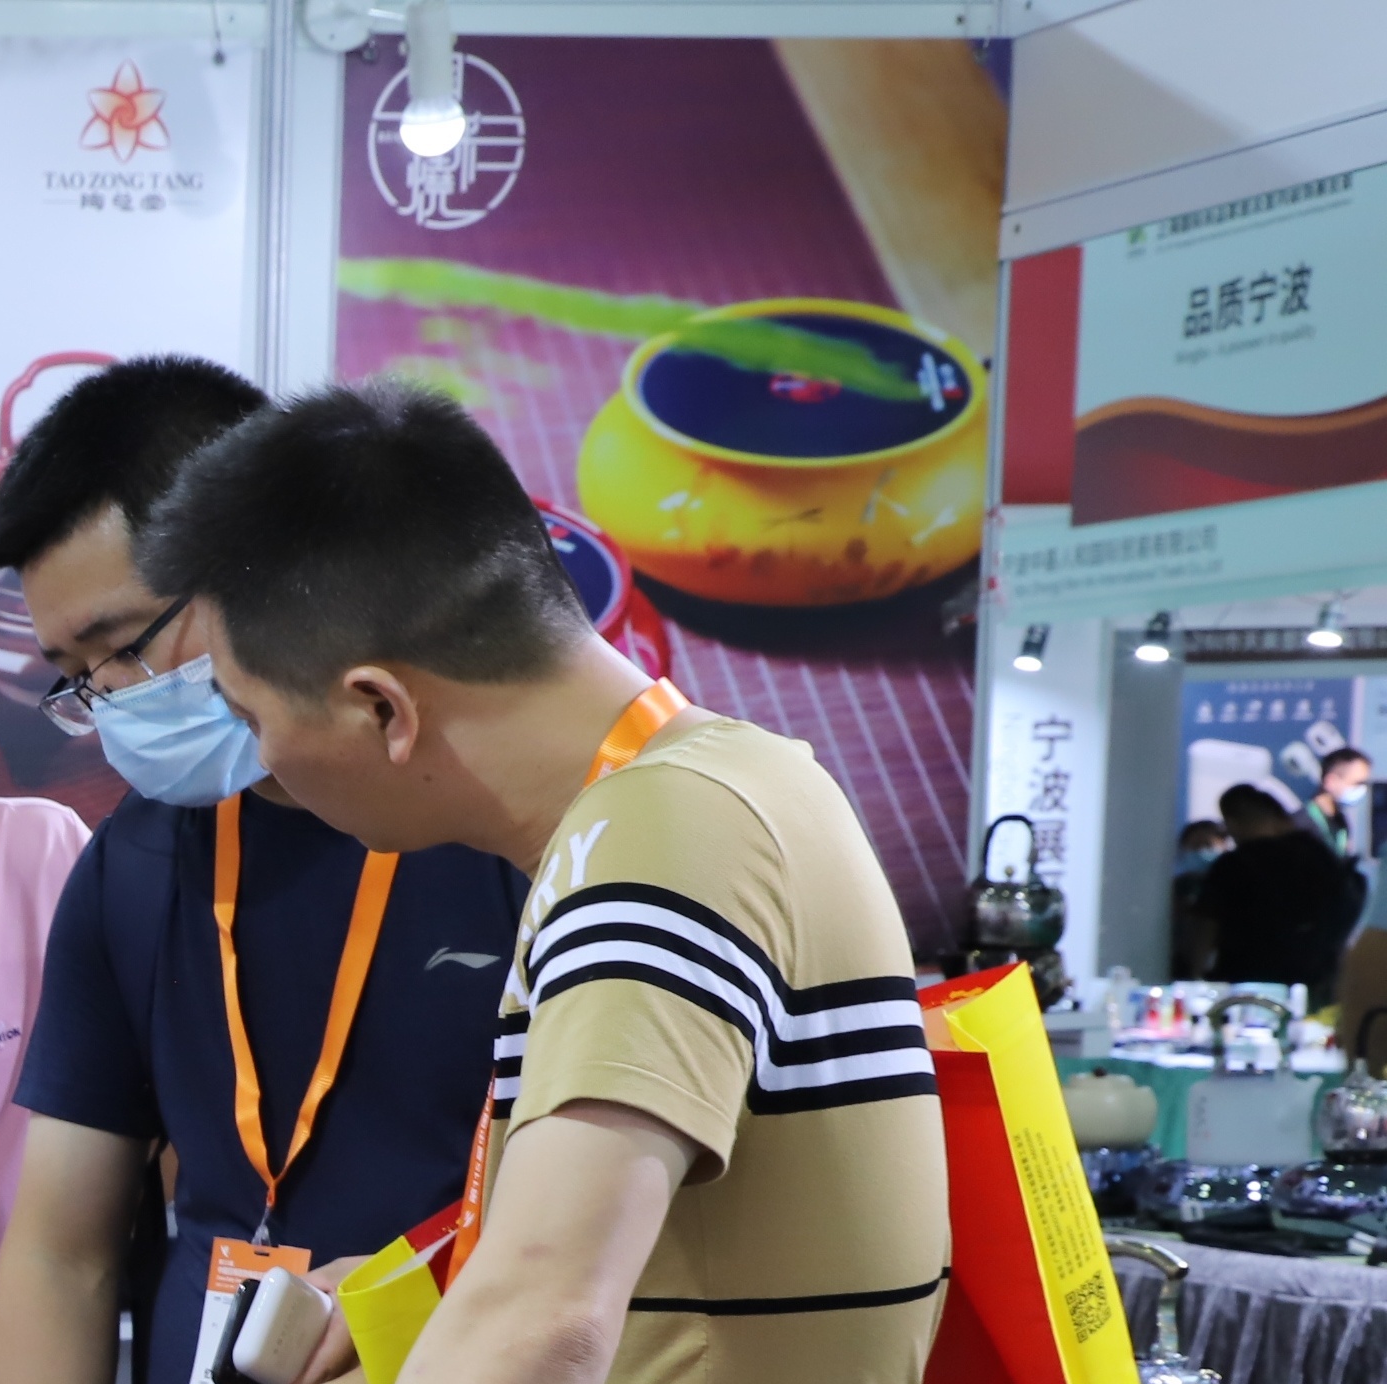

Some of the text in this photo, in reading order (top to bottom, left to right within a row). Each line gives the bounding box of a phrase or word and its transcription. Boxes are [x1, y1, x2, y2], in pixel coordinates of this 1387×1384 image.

[44, 171, 204, 191] TAO ZONG TANG
[1182, 261, 1314, 339] 品质宁波
